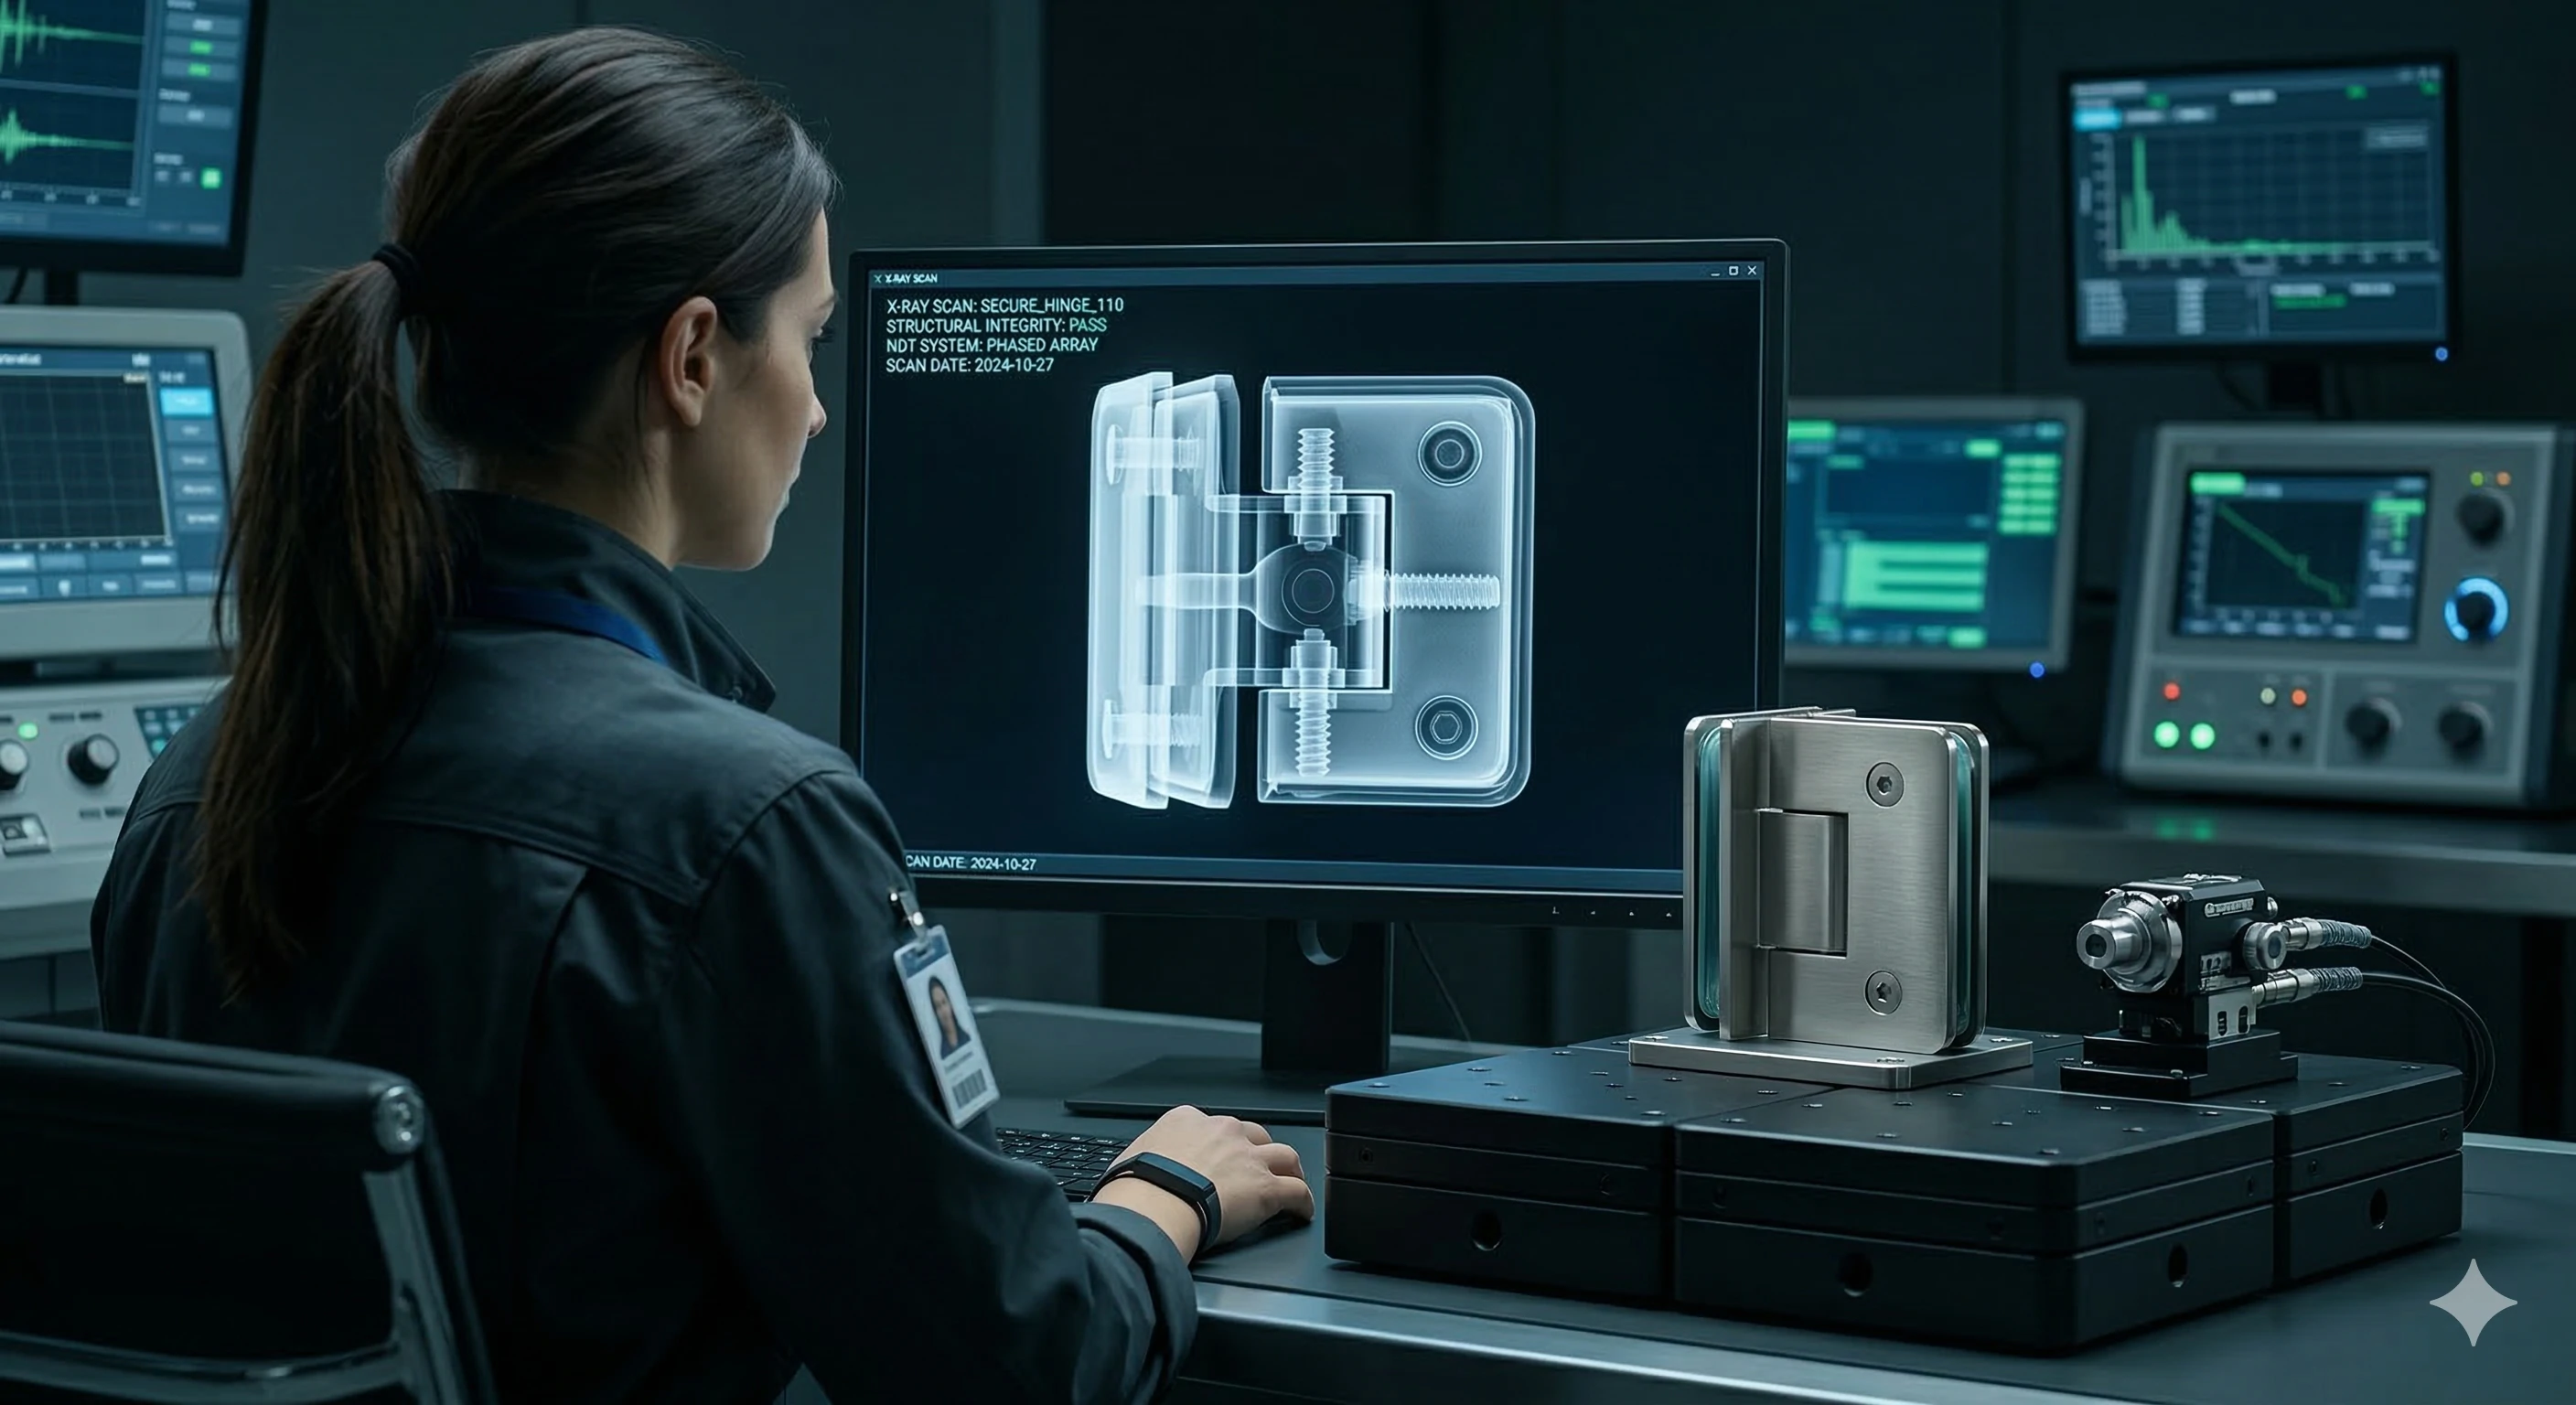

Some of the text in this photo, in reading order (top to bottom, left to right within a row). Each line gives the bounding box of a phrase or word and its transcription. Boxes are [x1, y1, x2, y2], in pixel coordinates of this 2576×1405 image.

[913, 273, 938, 284] SCAN
[886, 297, 1124, 314] X-RAY SCAN: SECURE_HINGE_110
[886, 316, 1107, 333] STRUCTURAL INTEGRITY: PASS
[886, 338, 1099, 353] NDT SYSTEM: PHASED ARRAY
[886, 358, 1055, 372] SCAN DATE: 2024-10-27
[906, 855, 930, 868] CAN
[971, 857, 1037, 871] 2024-10-27
